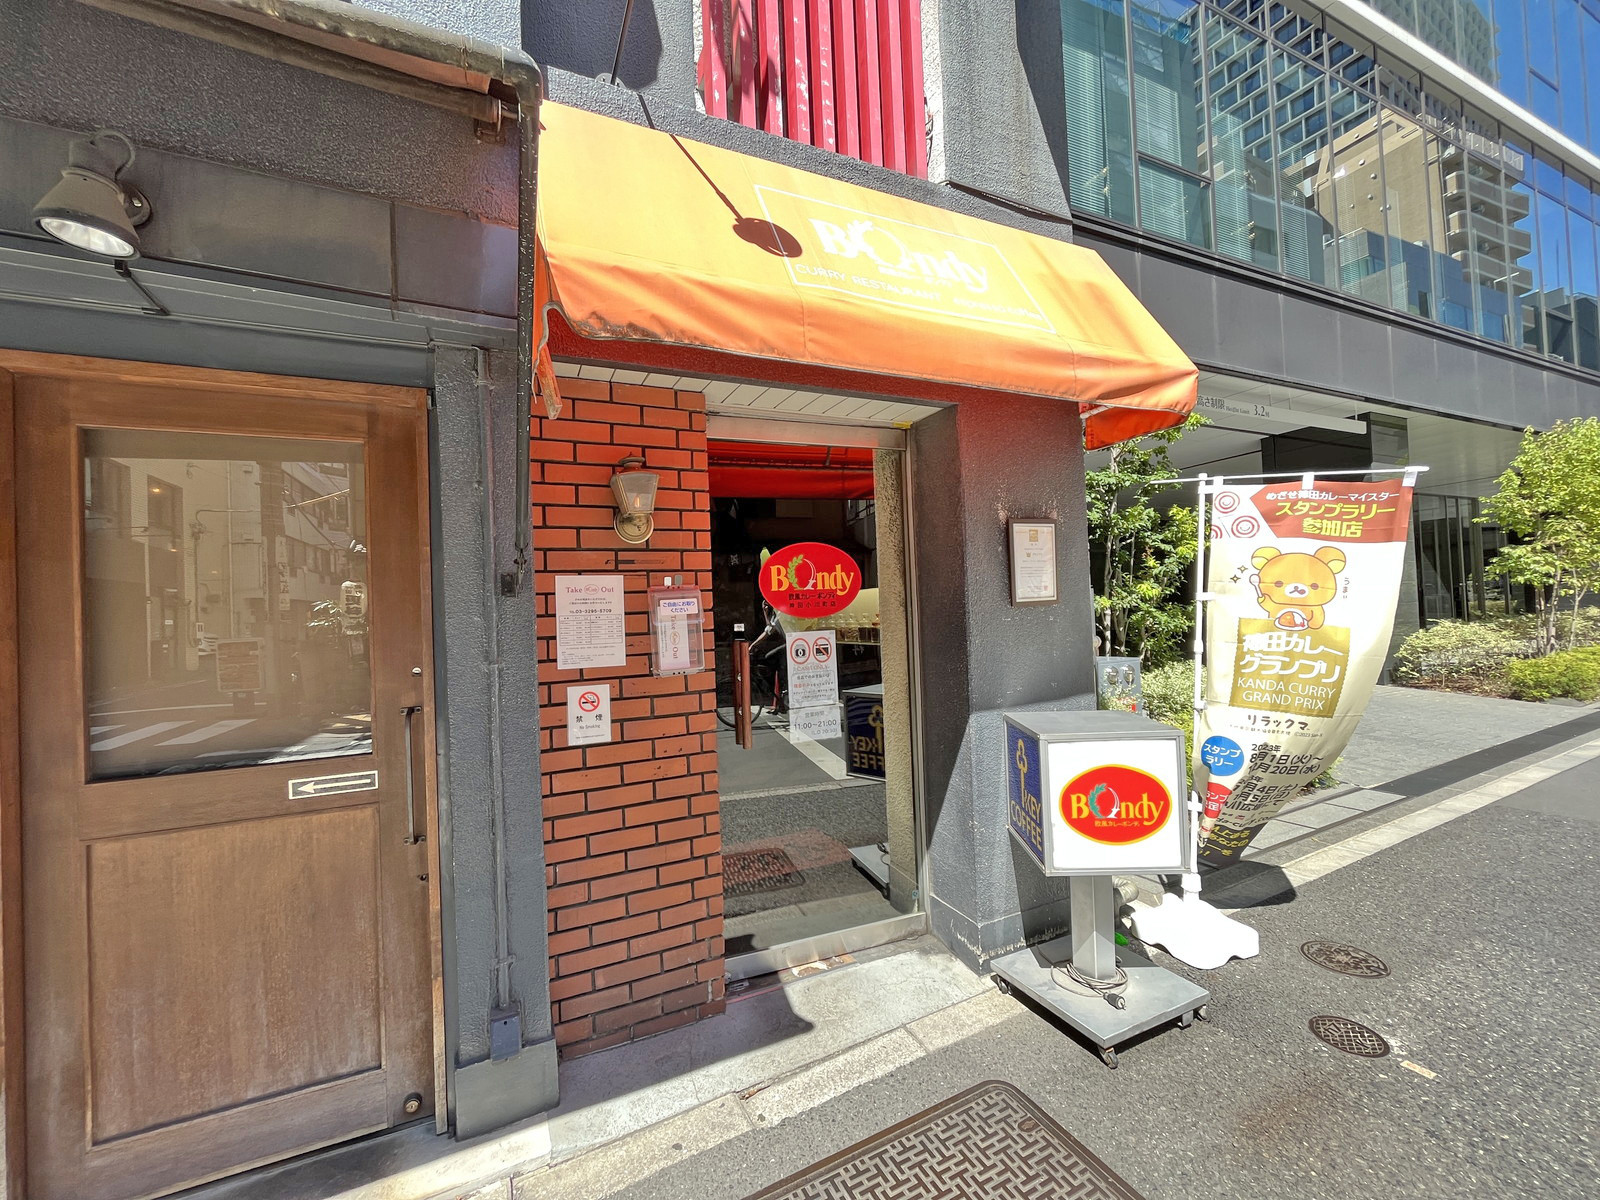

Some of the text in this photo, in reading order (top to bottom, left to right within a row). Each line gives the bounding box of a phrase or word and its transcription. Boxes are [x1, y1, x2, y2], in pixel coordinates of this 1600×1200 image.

[795, 263, 846, 281] CURRY
[851, 275, 942, 302] RESTAURANT
[1197, 396, 1225, 411] 高さ制限
[1275, 501, 1396, 520] スタンプラリー
[1302, 517, 1363, 538] 参加店
[1239, 653, 1341, 683] グランプリ
[1237, 677, 1337, 700] KANDA CURRY
[1242, 690, 1325, 711] GRAND PRIX
[1247, 714, 1309, 731] リラックマ
[1203, 742, 1242, 758] スタンプ
[1251, 743, 1282, 753] 2023年
[1205, 755, 1234, 767] ラリー
[1024, 789, 1042, 824] KEY
[1010, 800, 1043, 852] COFFEE
